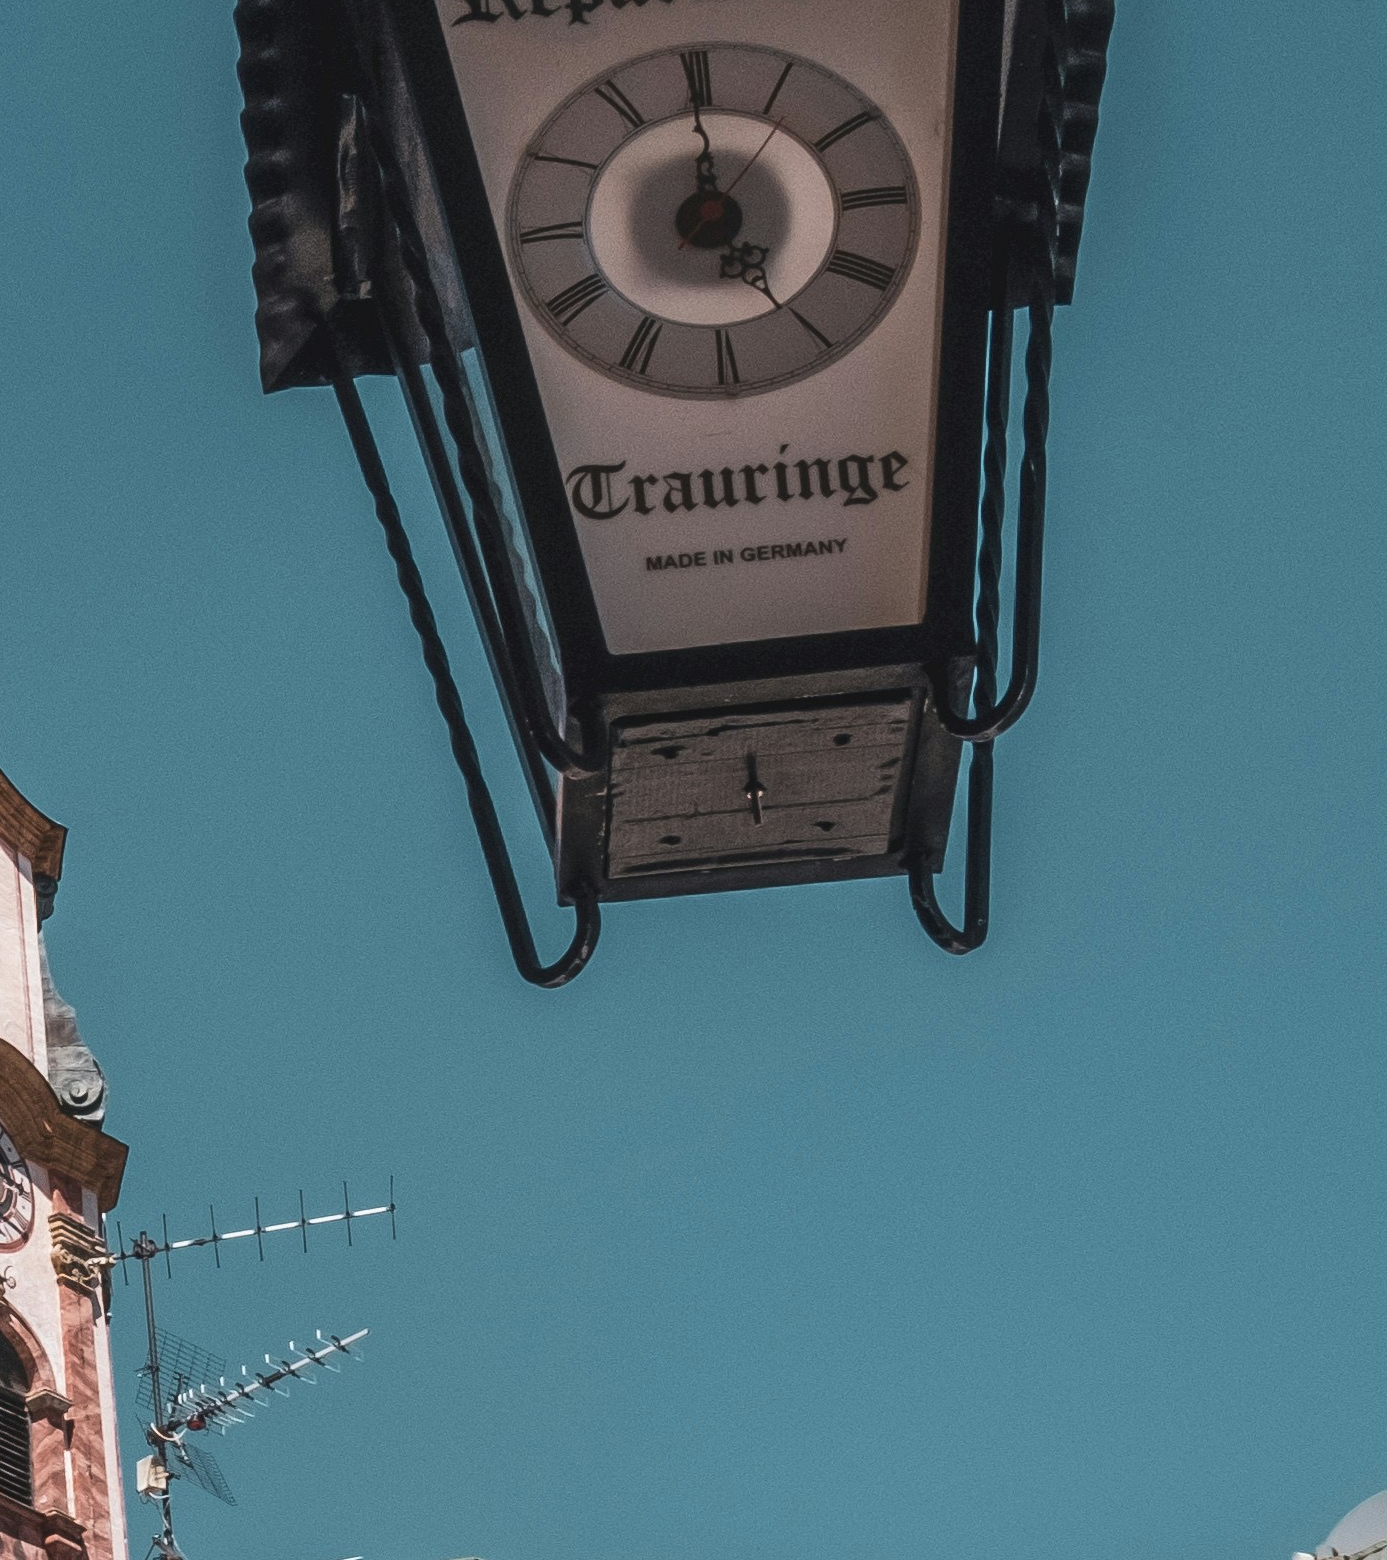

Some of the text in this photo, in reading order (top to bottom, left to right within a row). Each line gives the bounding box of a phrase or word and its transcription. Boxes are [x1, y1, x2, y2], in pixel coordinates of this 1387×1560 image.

[565, 443, 911, 522] Trauringe
[646, 538, 847, 571] MADE IN GERMANY
